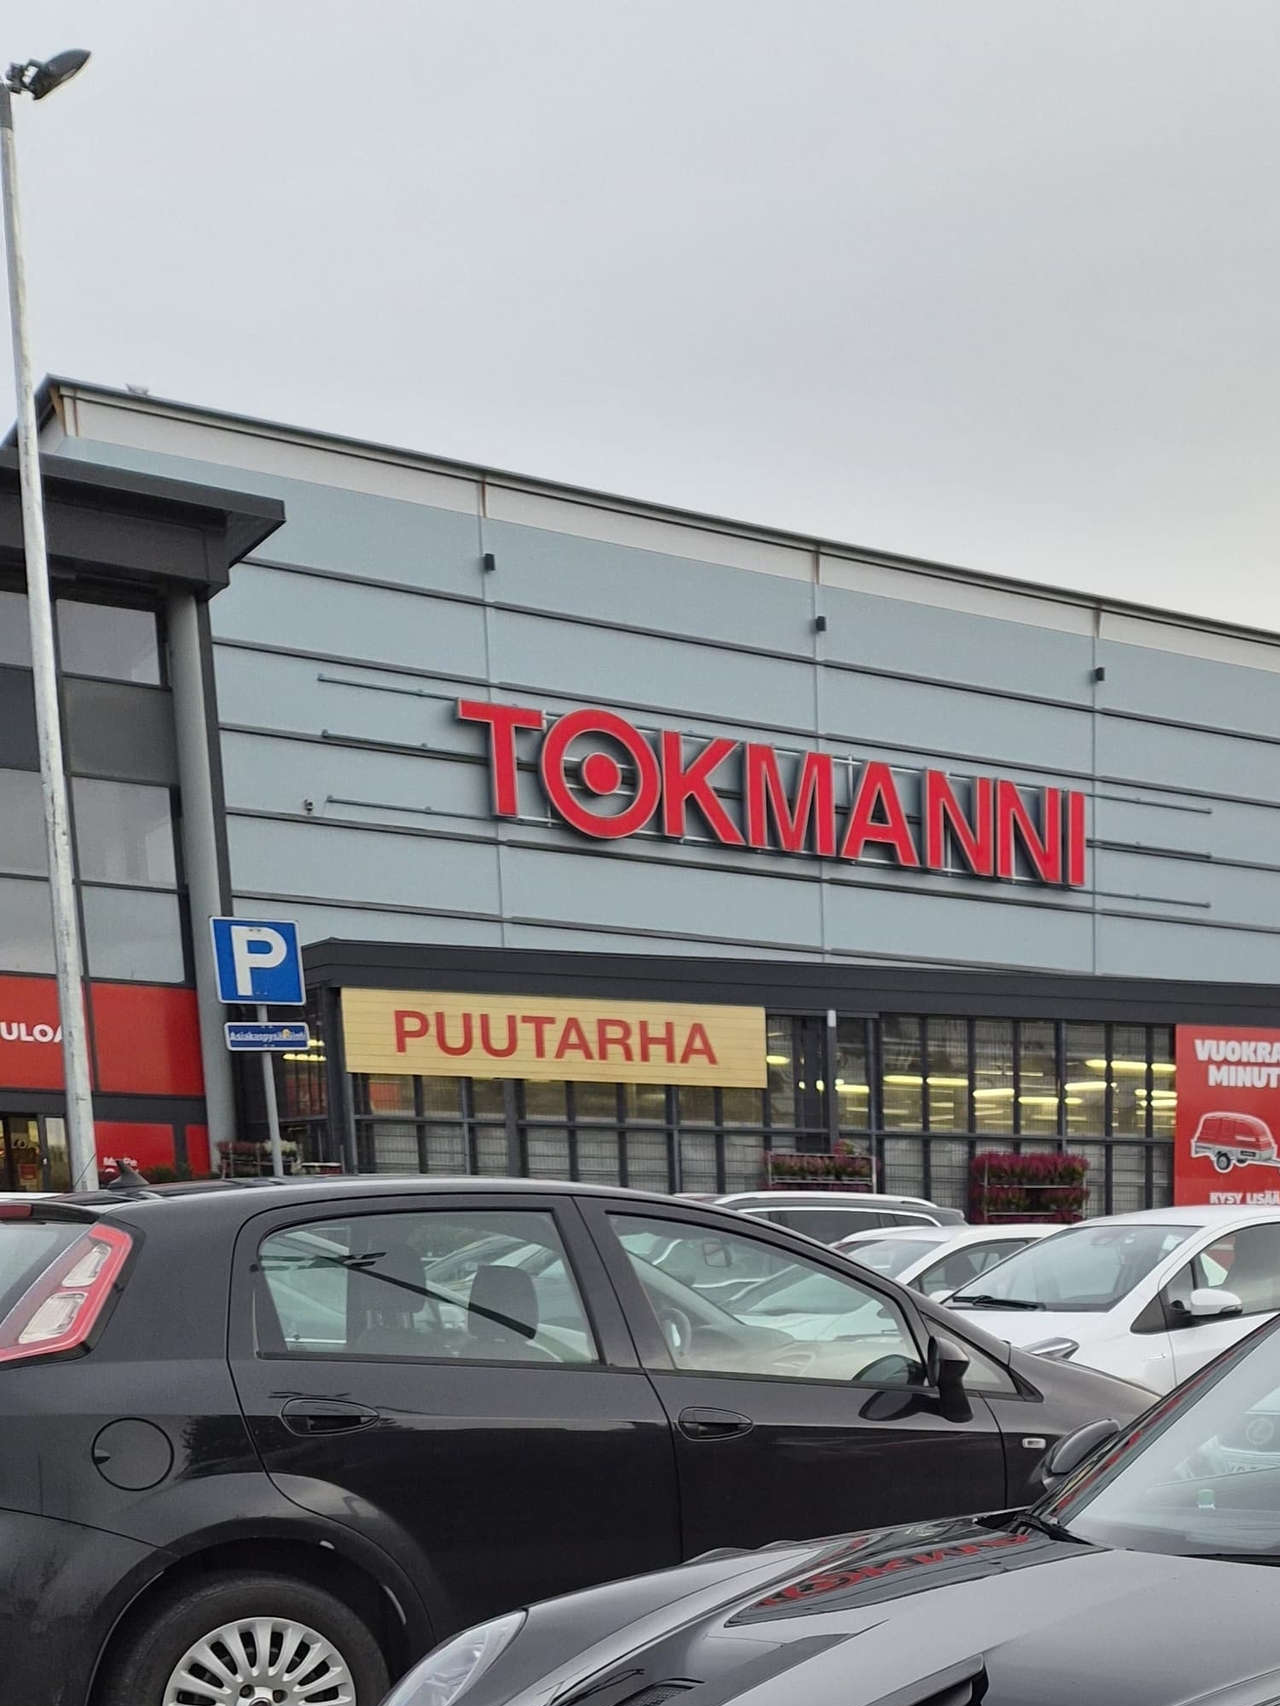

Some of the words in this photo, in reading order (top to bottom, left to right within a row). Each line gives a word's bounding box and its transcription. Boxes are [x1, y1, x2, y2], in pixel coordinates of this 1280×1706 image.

[457, 699, 1086, 888] TOKMANNI
[231, 925, 288, 996] P
[393, 1009, 718, 1066] PUUTARHA
[1209, 1192, 1243, 1205] KYSY
[1246, 1190, 1280, 1206] LISÄÄ
